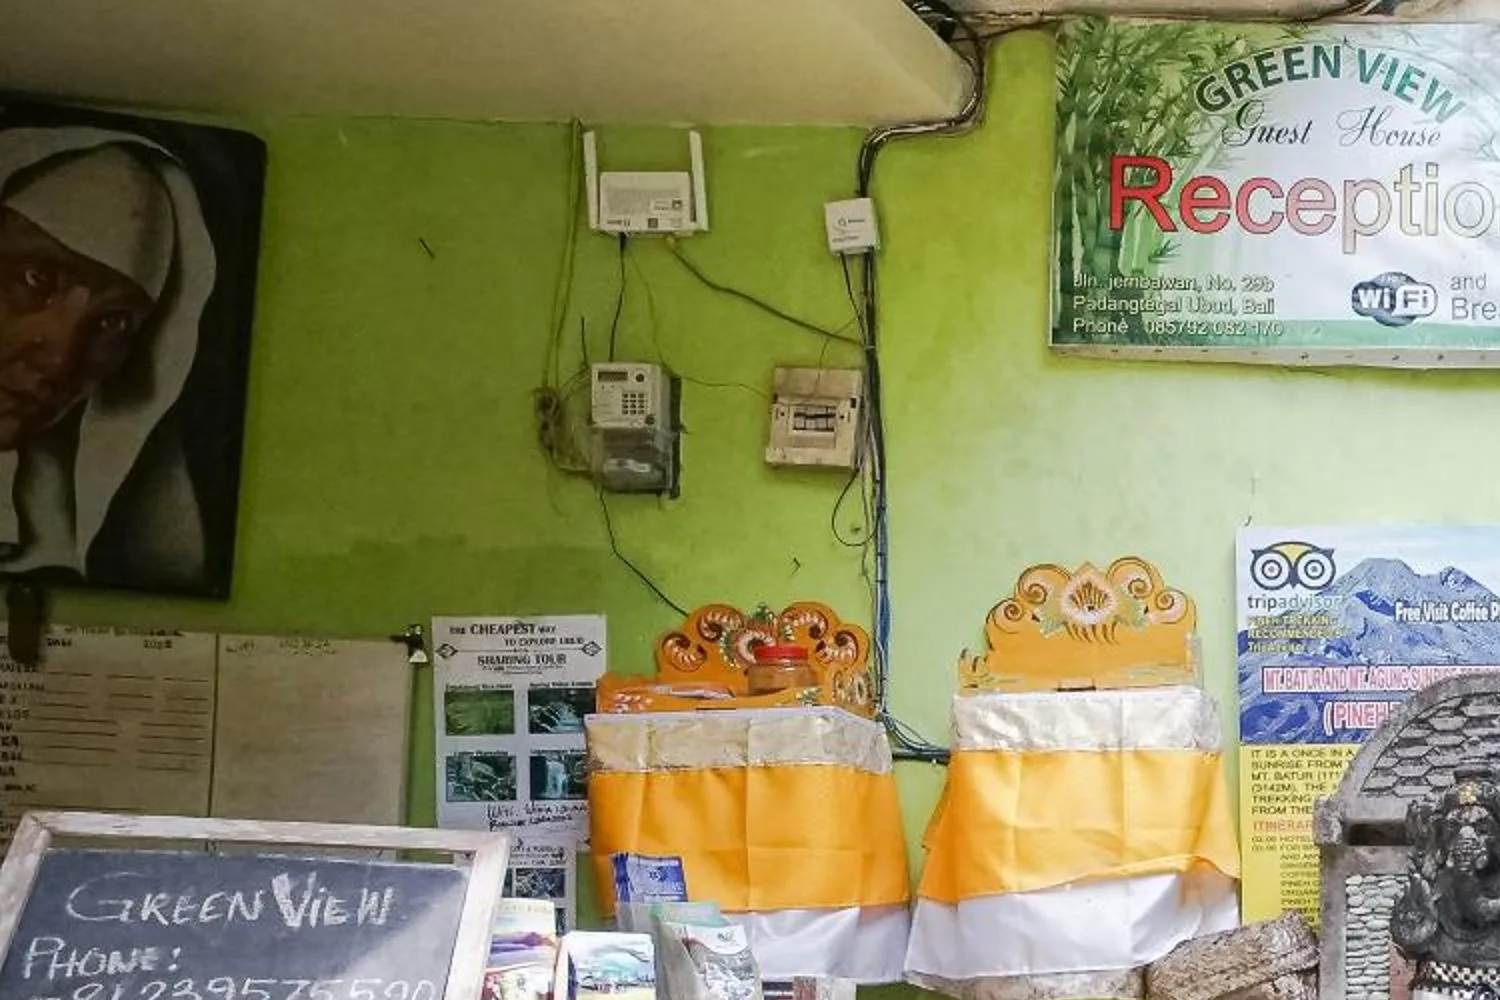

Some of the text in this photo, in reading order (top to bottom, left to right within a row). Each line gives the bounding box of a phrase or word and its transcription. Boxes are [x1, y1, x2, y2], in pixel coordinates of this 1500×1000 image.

[1195, 43, 1467, 124] GREEN VIEW
[1220, 99, 1442, 148] Guest House
[1450, 272, 1487, 291] and
[1242, 298, 1275, 315] Bali
[1247, 595, 1343, 613] tripadvisor
[1395, 600, 1421, 622] Free
[1423, 601, 1449, 622] Visit
[1450, 601, 1489, 622] Coffee
[470, 623, 536, 635] CHEAPEST
[534, 653, 567, 665] TOUR
[1285, 668, 1321, 692] BATUR
[1370, 667, 1409, 691] AGUNG
[1251, 749, 1260, 758] IT
[1265, 749, 1277, 758] IS
[1279, 749, 1289, 758] A
[1291, 749, 1326, 758] ONCE
[1329, 749, 1341, 758] IN
[1251, 759, 1342, 770] SUNRISE FROM
[1273, 771, 1313, 781] BATUR
[1305, 783, 1327, 792] THE
[1252, 795, 1312, 804] TREKKING
[1251, 805, 1313, 815] FROM THE
[66, 871, 265, 923] GREEN
